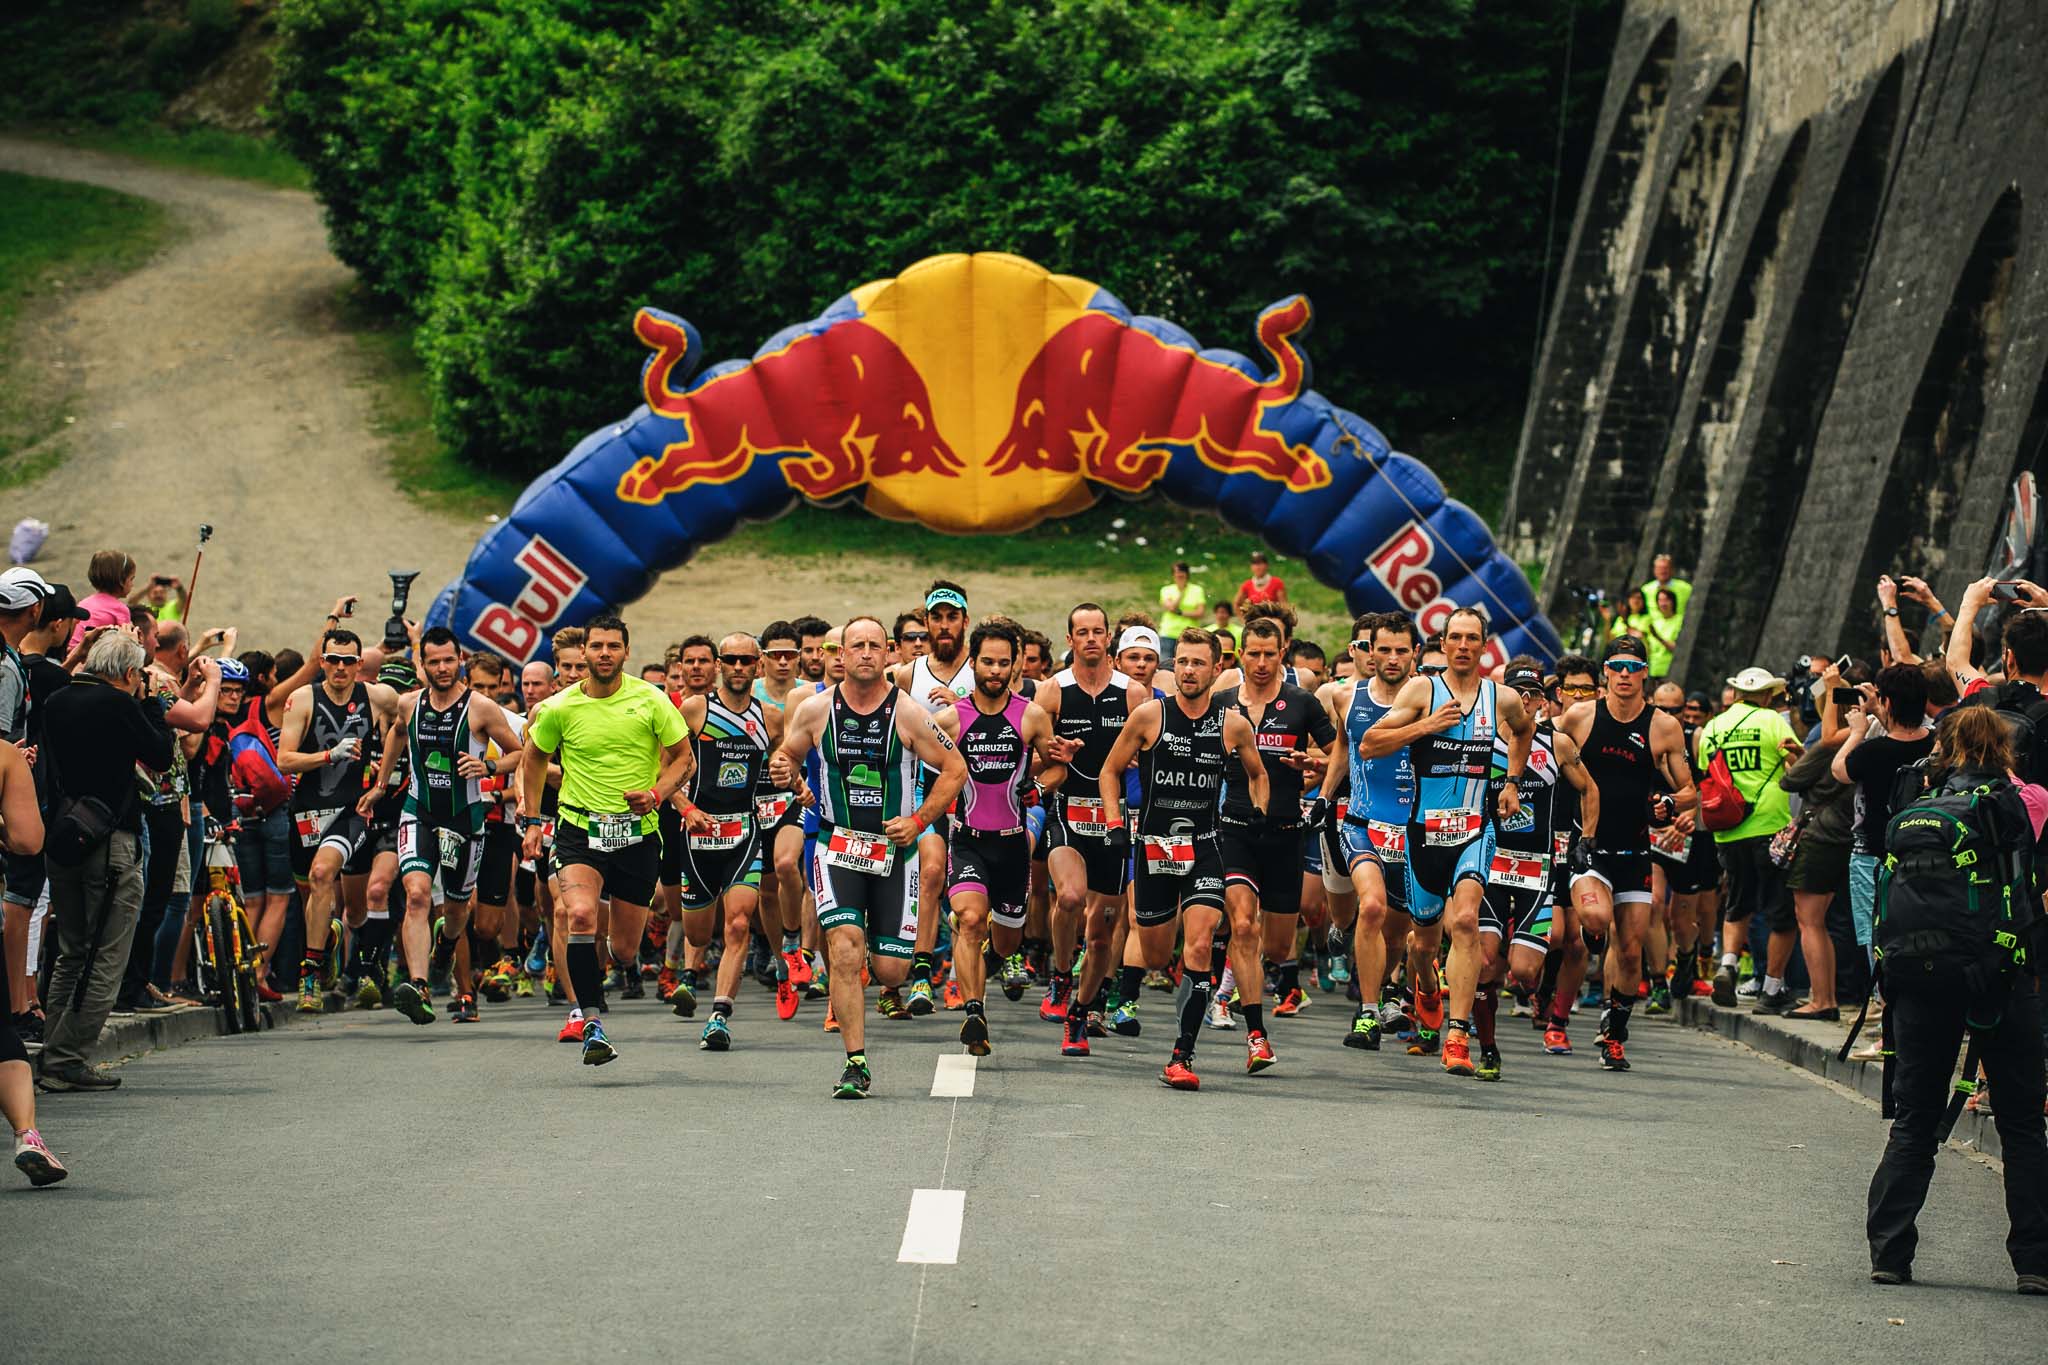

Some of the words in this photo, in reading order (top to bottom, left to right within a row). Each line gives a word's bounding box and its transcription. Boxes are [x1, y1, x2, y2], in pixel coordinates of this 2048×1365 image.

[471, 535, 586, 664] Bull
[931, 590, 958, 600] HOKA
[716, 740, 732, 749] ideal
[733, 742, 757, 751] systems
[967, 743, 1014, 752] LARRUZEA
[1432, 740, 1462, 751] WOLF
[721, 752, 750, 760] HEAVY
[1726, 748, 1757, 770] EW
[984, 761, 1016, 770] Bikes
[726, 768, 741, 780] AA
[721, 777, 745, 787] DRINK
[849, 796, 883, 804] EXPO
[1517, 791, 1534, 800] AVY
[759, 802, 775, 817] 34
[1090, 807, 1097, 823] 1
[597, 822, 632, 838] 1003
[711, 823, 721, 837] 3
[1439, 816, 1468, 832] 440
[1504, 818, 1533, 833] DRINK
[1899, 818, 1942, 830] DAKINE
[1196, 829, 1218, 841] HUUB
[1383, 832, 1401, 850] 21
[697, 837, 713, 845] VAN
[714, 837, 736, 846] DAELE
[845, 839, 873, 857] 186
[835, 852, 876, 869] MUCHERY
[1510, 859, 1520, 874] 2
[1500, 872, 1526, 884] LUXEM
[820, 912, 857, 926] VERGE
